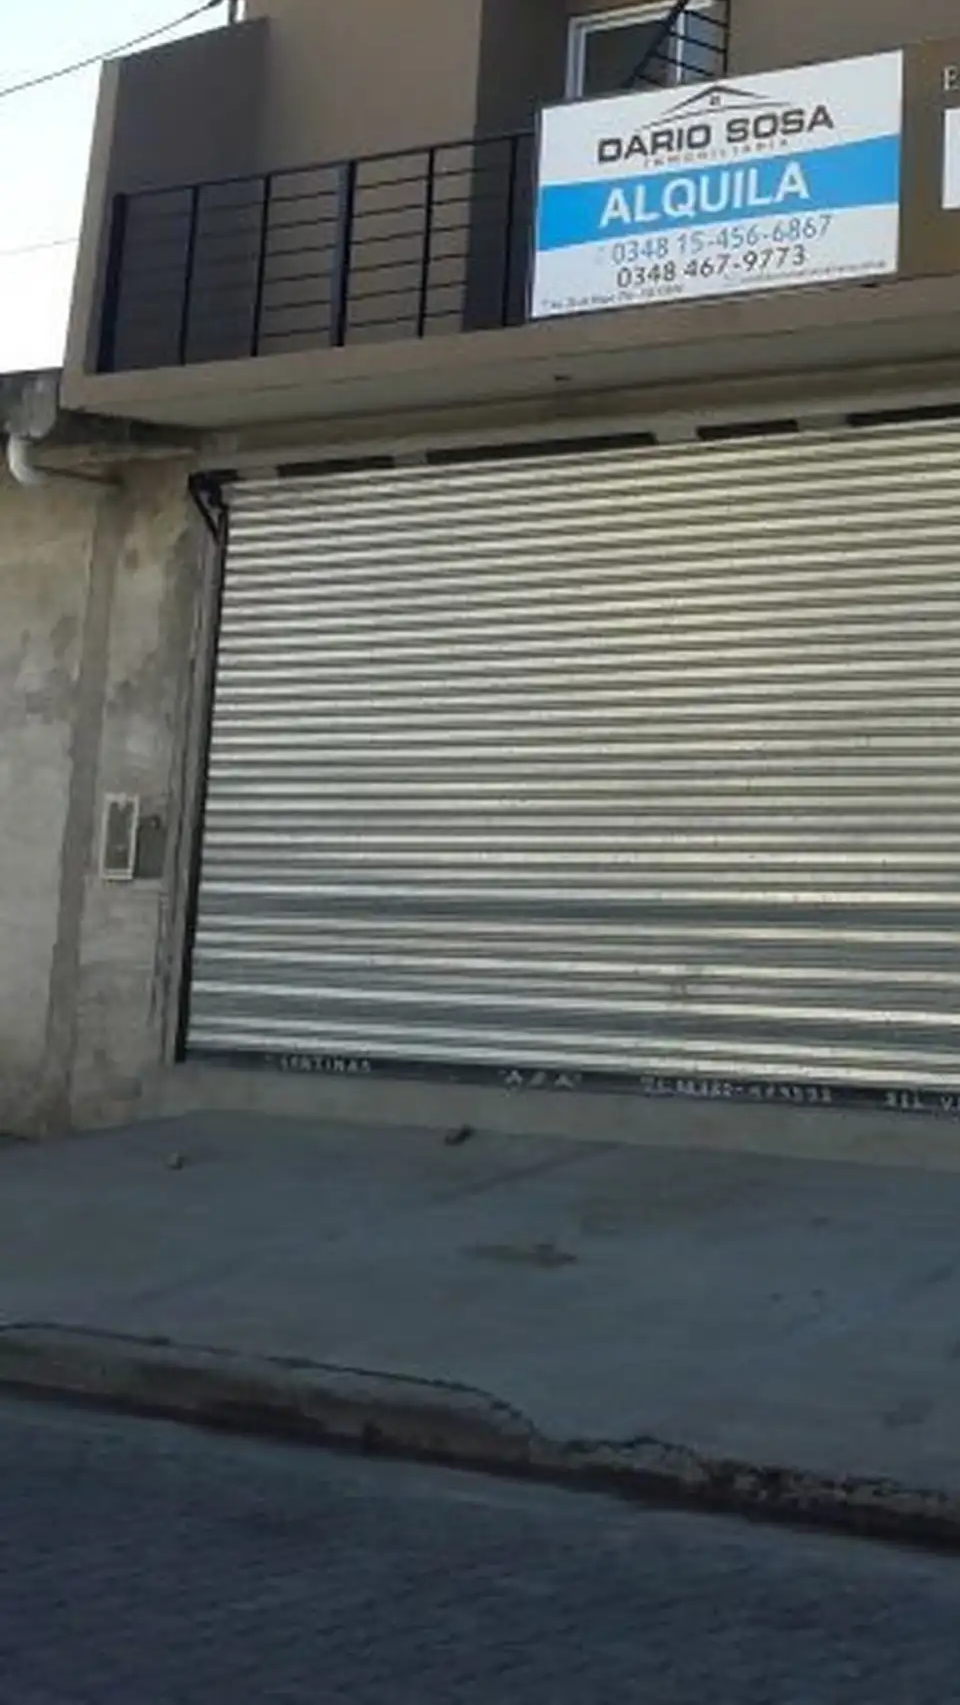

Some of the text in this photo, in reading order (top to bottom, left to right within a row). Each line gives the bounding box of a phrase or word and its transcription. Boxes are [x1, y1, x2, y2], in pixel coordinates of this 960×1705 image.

[598, 104, 834, 163] DARIO SOSA
[598, 162, 810, 228] ALQUILA
[611, 213, 832, 266] 0348 15-456-6867
[616, 259, 676, 289] 0348
[684, 243, 807, 279] 467-9773
